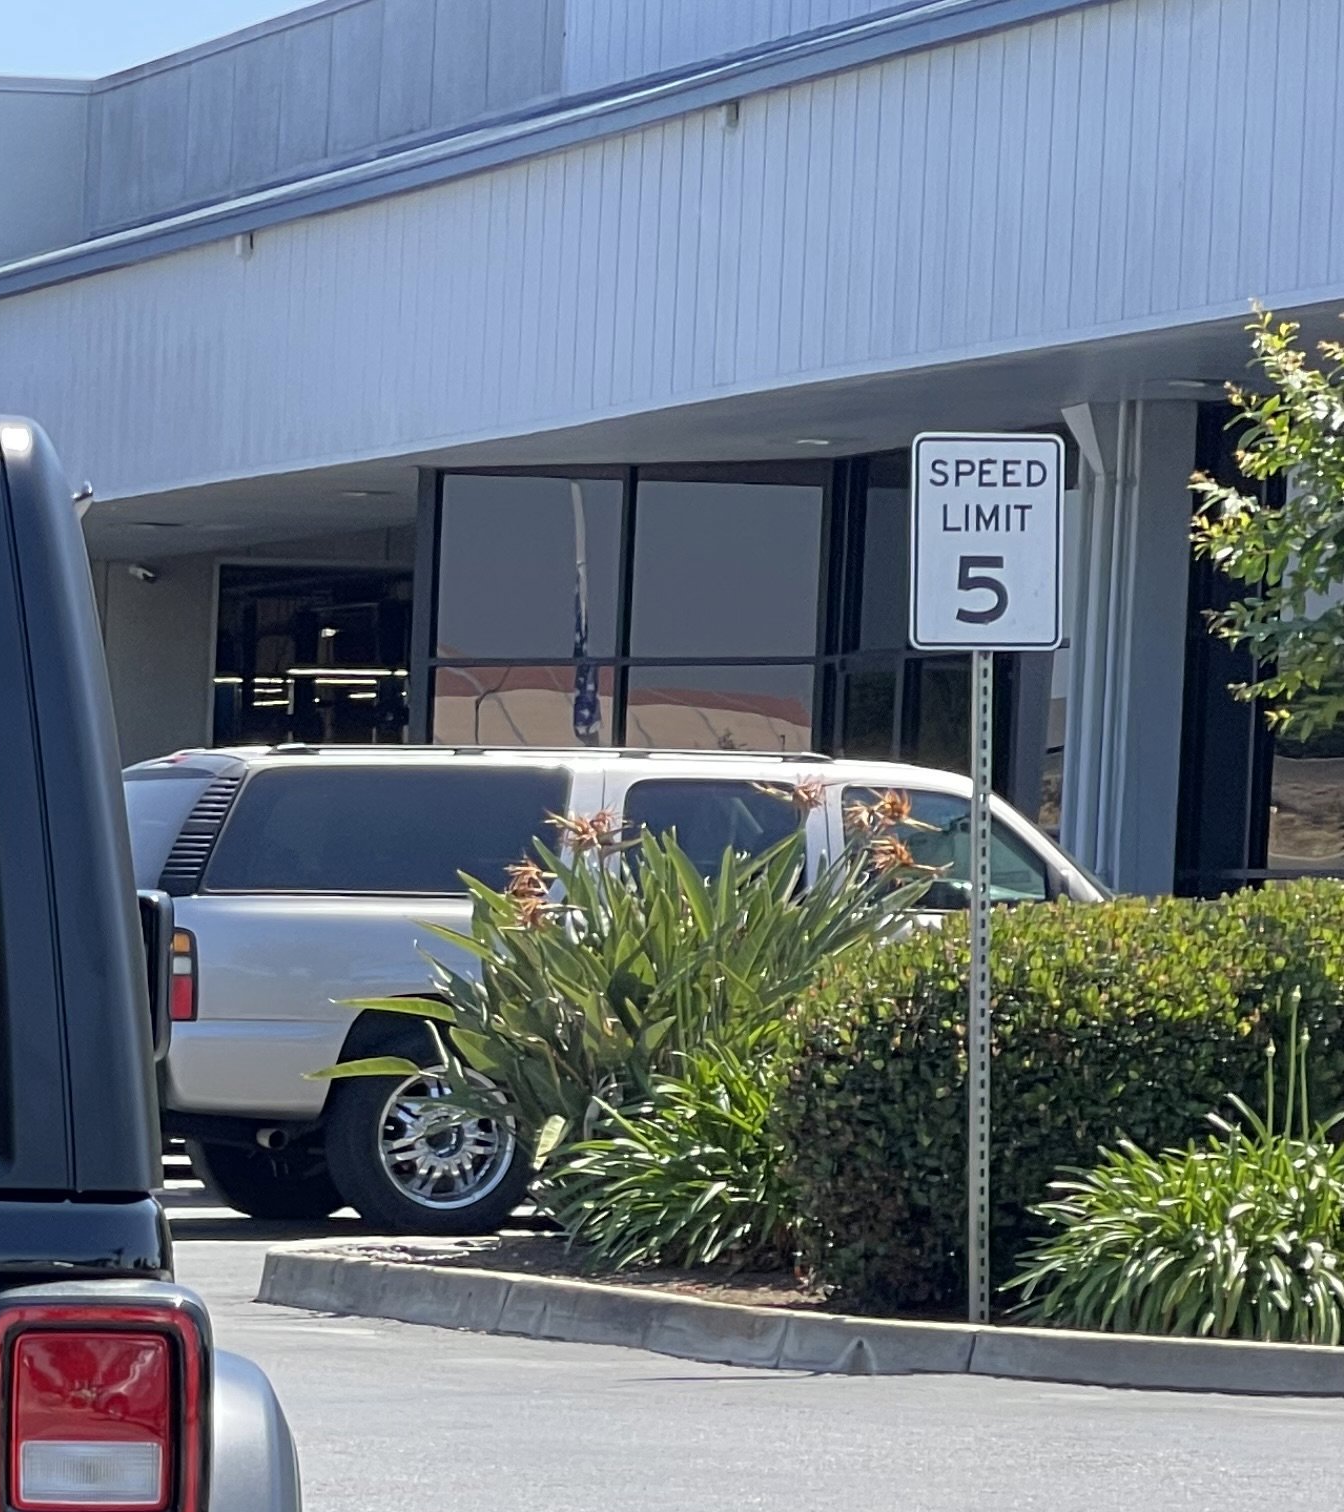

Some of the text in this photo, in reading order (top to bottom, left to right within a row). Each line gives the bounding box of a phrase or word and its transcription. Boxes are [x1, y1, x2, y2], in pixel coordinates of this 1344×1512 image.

[929, 458, 1047, 487] SPEED
[942, 504, 1033, 532] LIMIT
[955, 555, 1009, 625] 5
